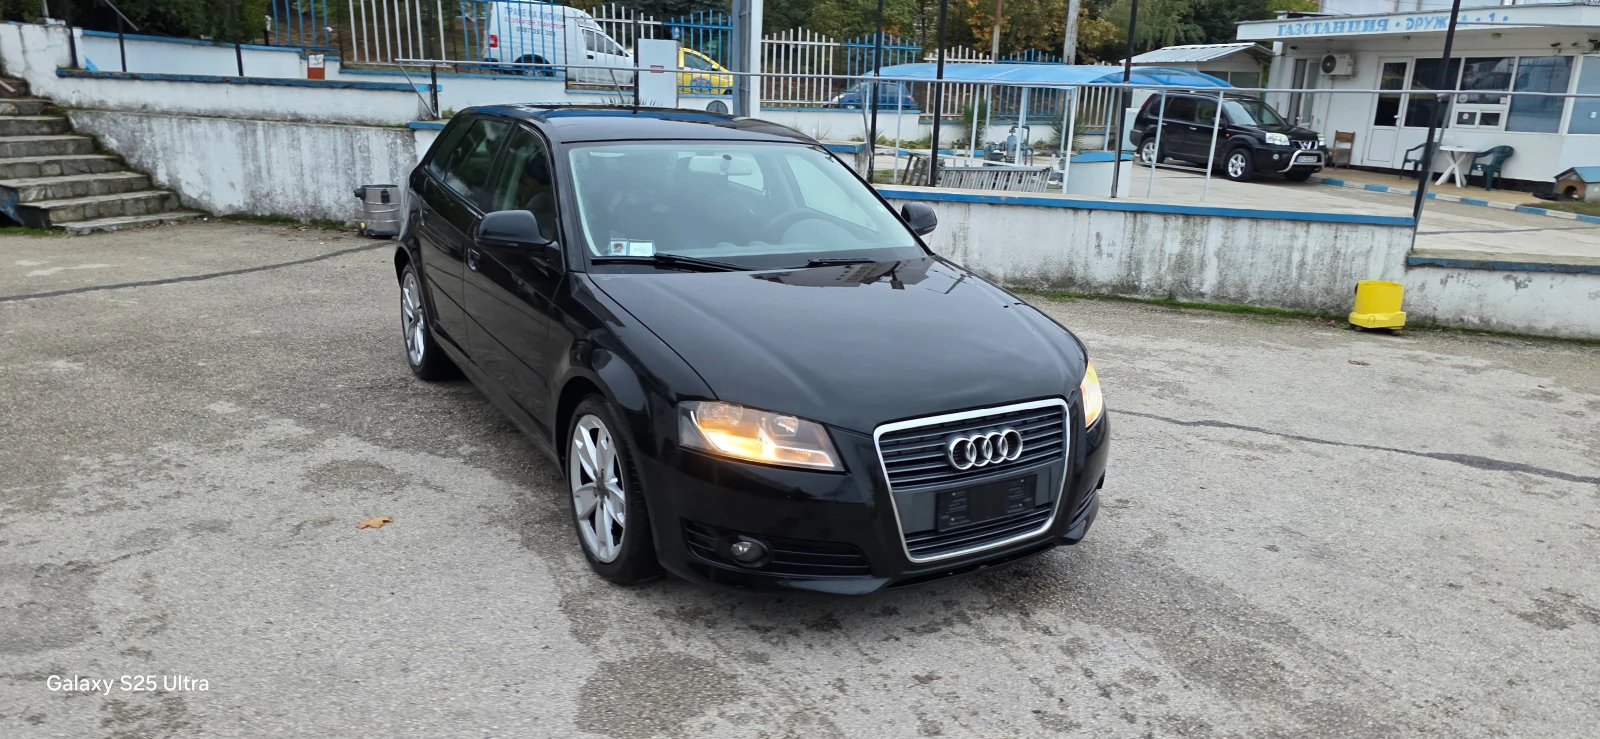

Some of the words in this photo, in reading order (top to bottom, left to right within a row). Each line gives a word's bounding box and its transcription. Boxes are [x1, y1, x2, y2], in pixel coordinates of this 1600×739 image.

[504, 17, 536, 25] БЗПАТЕН
[537, 21, 567, 29] ТАНПОРТ
[1277, 18, 1390, 36] ГАЗСТАНЦИЯ
[1405, 15, 1468, 31] ДРУЖА
